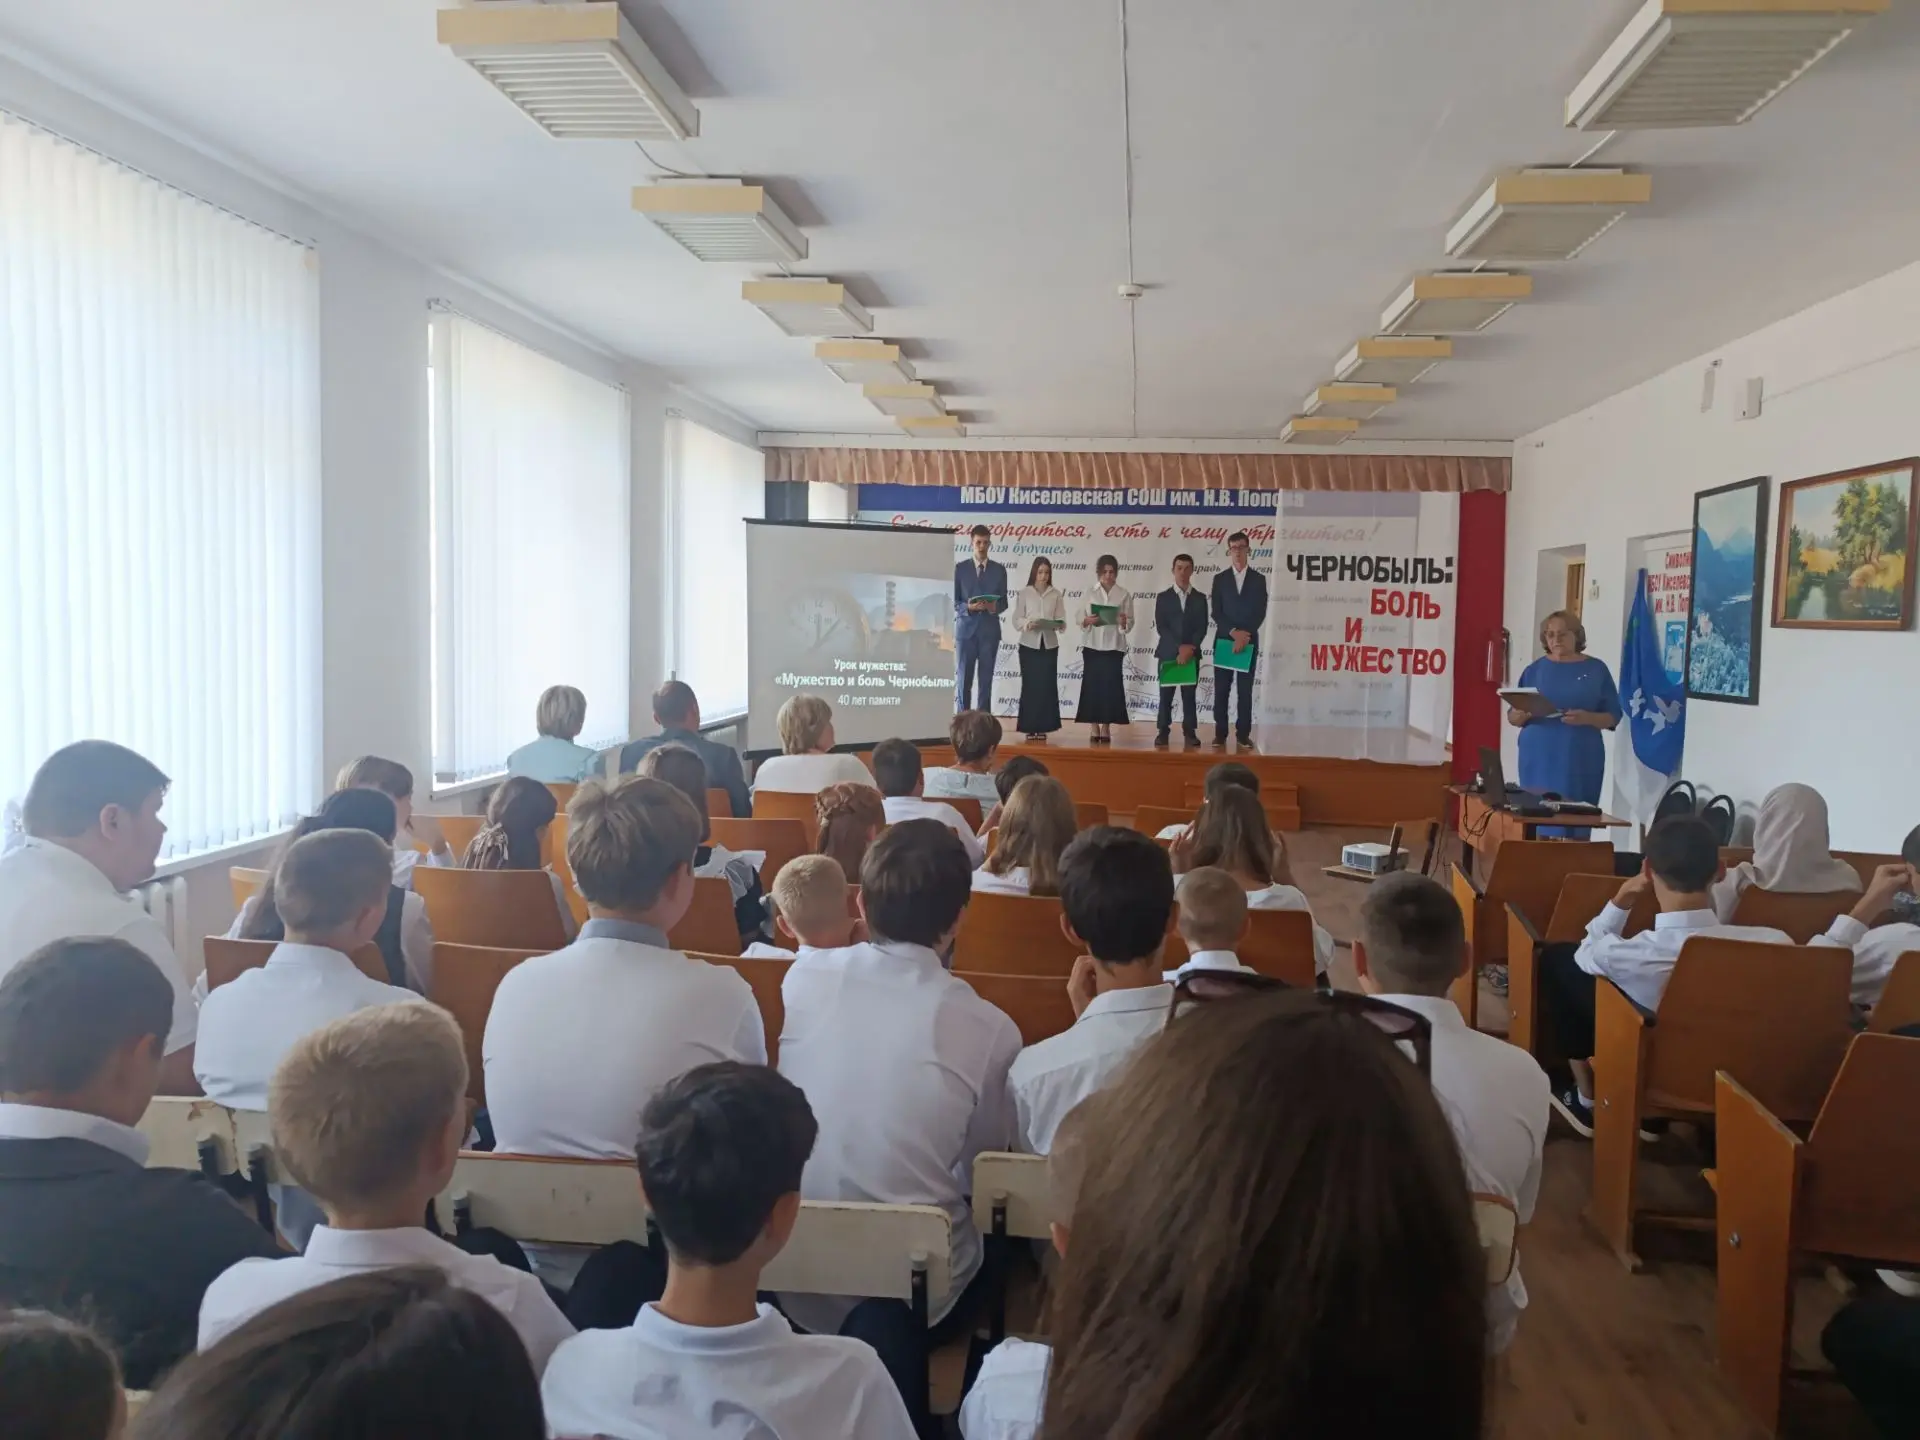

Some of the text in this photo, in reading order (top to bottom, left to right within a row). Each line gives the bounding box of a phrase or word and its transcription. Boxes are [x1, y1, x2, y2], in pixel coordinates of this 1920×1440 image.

[960, 487, 1006, 504] МБОУ
[1008, 487, 1123, 506] Киселевская
[1127, 488, 1167, 506] СОШ
[1170, 491, 1200, 506] им.
[1203, 489, 1235, 507] Н.В.
[1104, 522, 1151, 538] есть
[1158, 526, 1171, 539] к
[1181, 526, 1228, 545] чему
[1012, 542, 1074, 558] будущего
[1286, 553, 1454, 585] ЧЕРНОБЫЛЬ:
[1370, 588, 1441, 620] БОЛЬ
[1344, 616, 1363, 644] И
[833, 658, 907, 673] Урок мужества:
[1310, 643, 1447, 676] МУЖЕСТВО
[775, 672, 956, 690] «Мужество и боль Чернобыля»
[837, 694, 901, 706] 40 лет памяти
